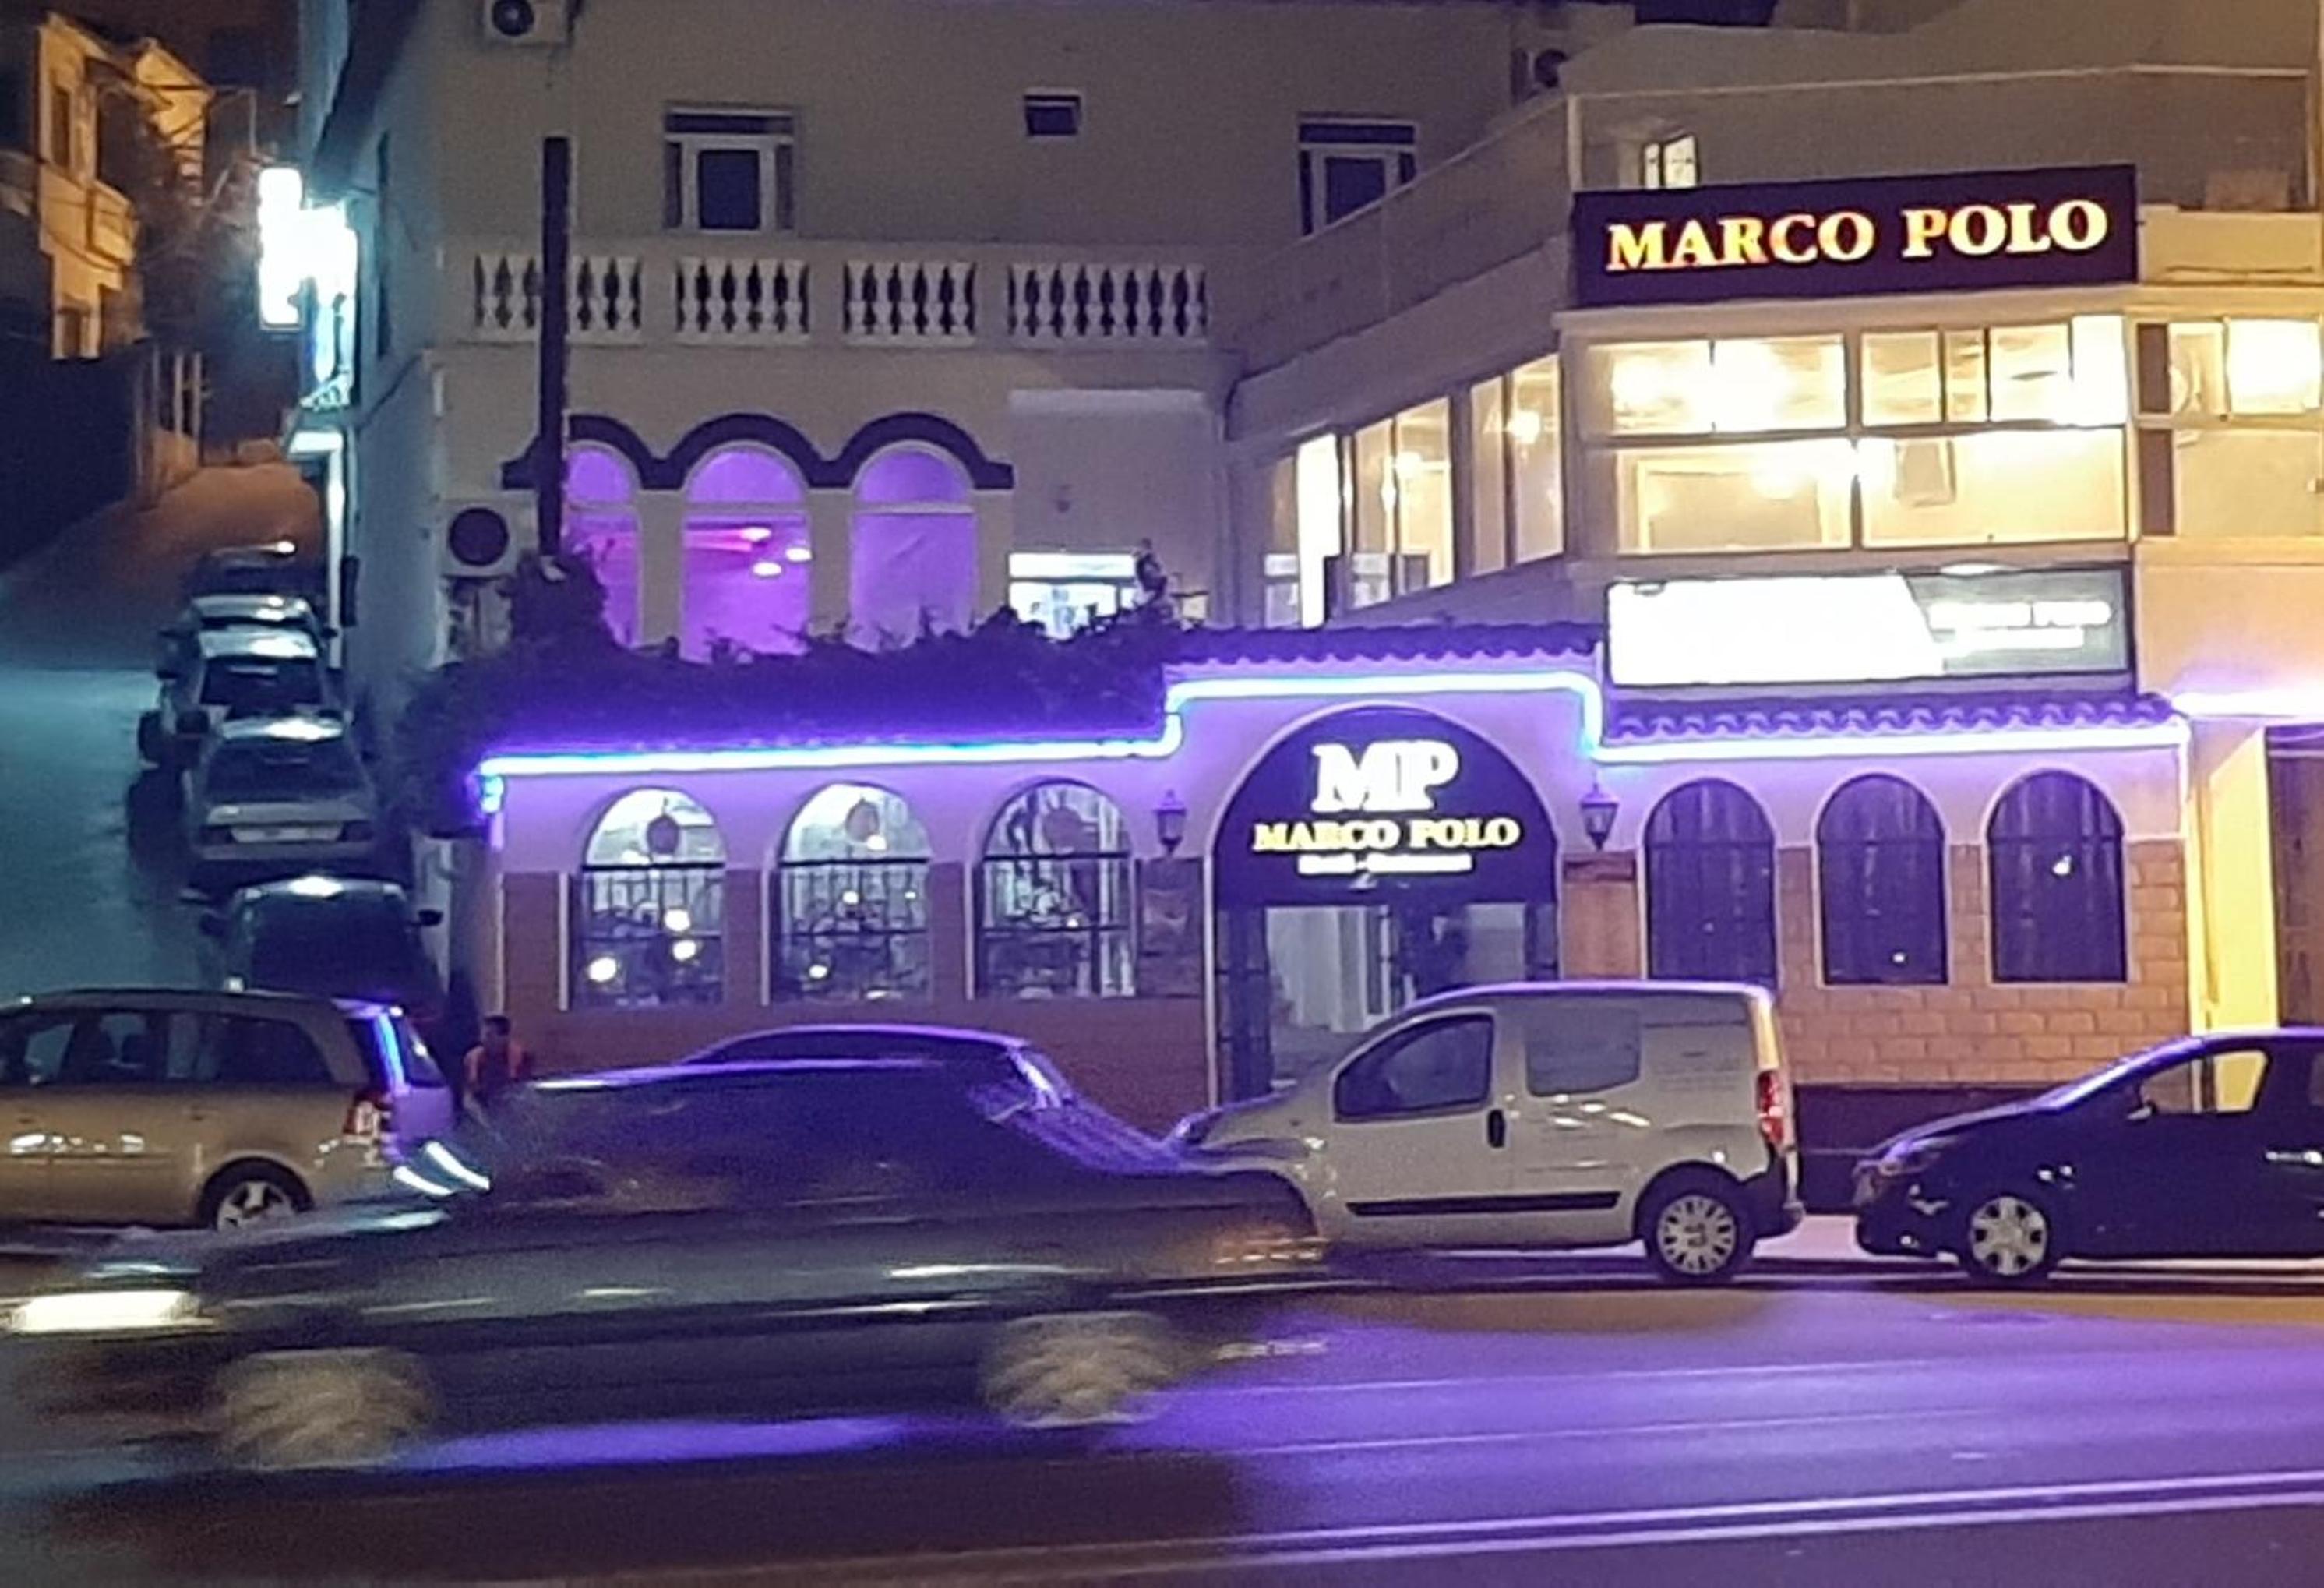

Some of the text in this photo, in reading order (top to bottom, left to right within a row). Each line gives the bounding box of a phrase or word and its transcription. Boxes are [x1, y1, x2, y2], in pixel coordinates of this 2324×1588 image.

[1606, 199, 2108, 272] MARCO POLO
[1312, 740, 1458, 812] MP
[1253, 818, 1520, 851] MARCO POLO
